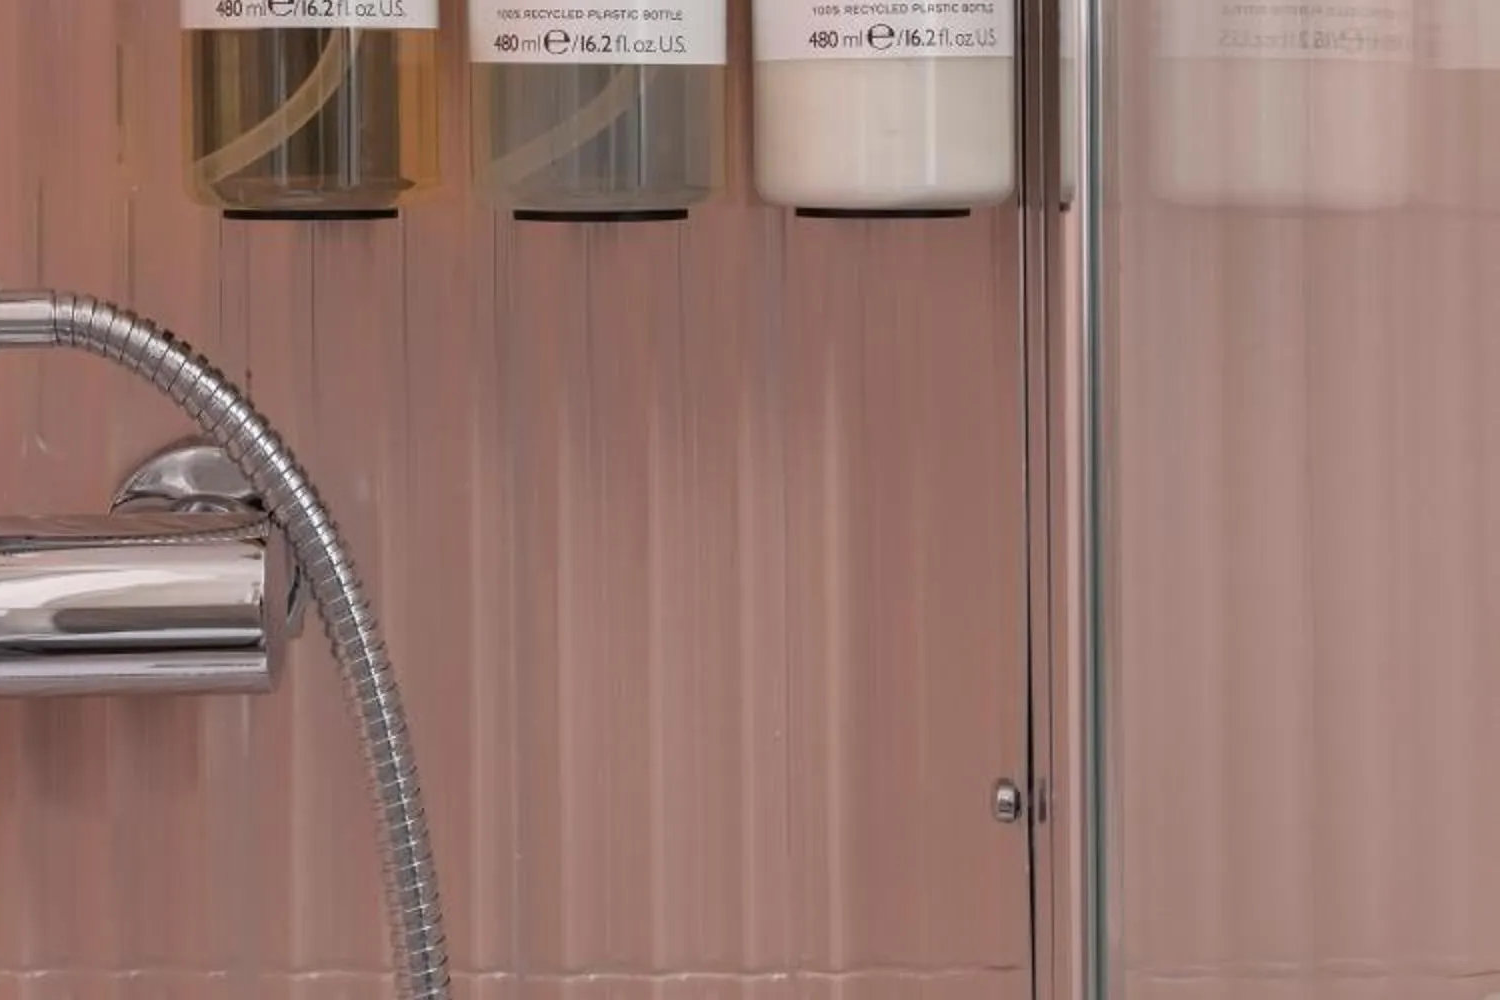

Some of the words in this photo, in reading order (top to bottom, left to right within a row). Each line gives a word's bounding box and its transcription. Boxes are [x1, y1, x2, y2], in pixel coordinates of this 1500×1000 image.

[216, 0, 243, 17] 480
[523, 9, 584, 19] RECYCLED
[587, 9, 639, 20] PLASTIC
[643, 9, 683, 21] BOTTLE
[844, 3, 909, 15] RECYCLED
[911, 2, 959, 15] PLASTIC
[494, 33, 519, 52] 480
[809, 29, 839, 49] 480
